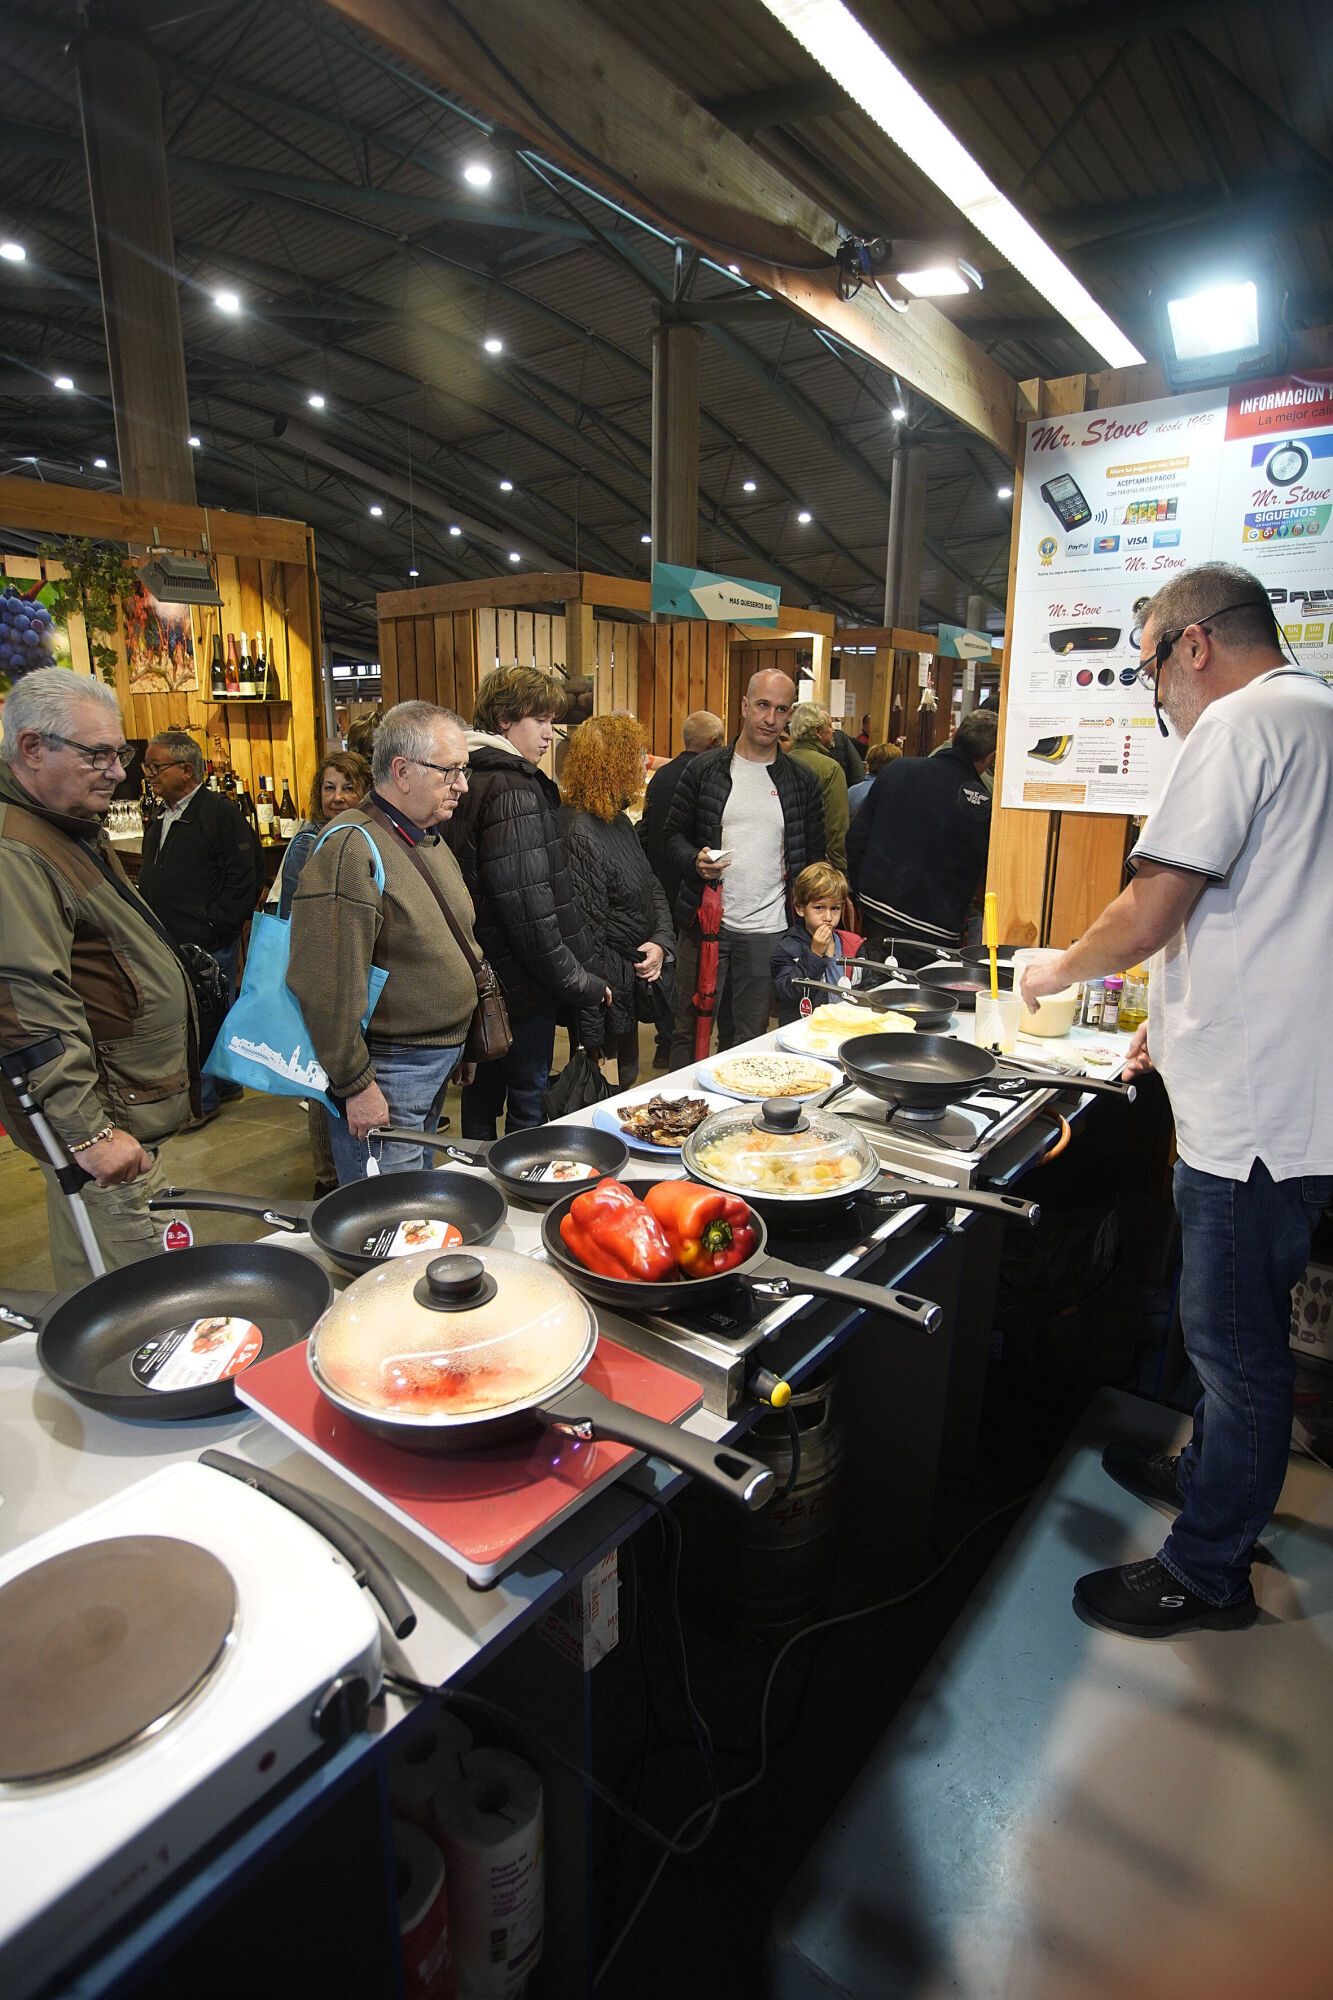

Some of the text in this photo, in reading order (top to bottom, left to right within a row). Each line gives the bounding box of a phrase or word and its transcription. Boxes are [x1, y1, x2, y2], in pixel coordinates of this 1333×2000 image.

[1240, 384, 1325, 415] INFORMACION
[1258, 416, 1272, 426] La
[1275, 410, 1309, 423] mejor
[1031, 425, 1075, 452] Mr.
[1081, 418, 1148, 447] Stove
[1155, 420, 1183, 434] desde
[1116, 473, 1176, 487] ACEPTAMOS PAGOS
[1252, 486, 1331, 507] Mr. Stove
[1067, 542, 1089, 551] PayPal
[1127, 536, 1148, 546] VISA
[1125, 555, 1187, 572] Mr. Stove
[729, 597, 773, 611] MAS QUESEROS BIO
[1048, 603, 1102, 617] Mr. Stove
